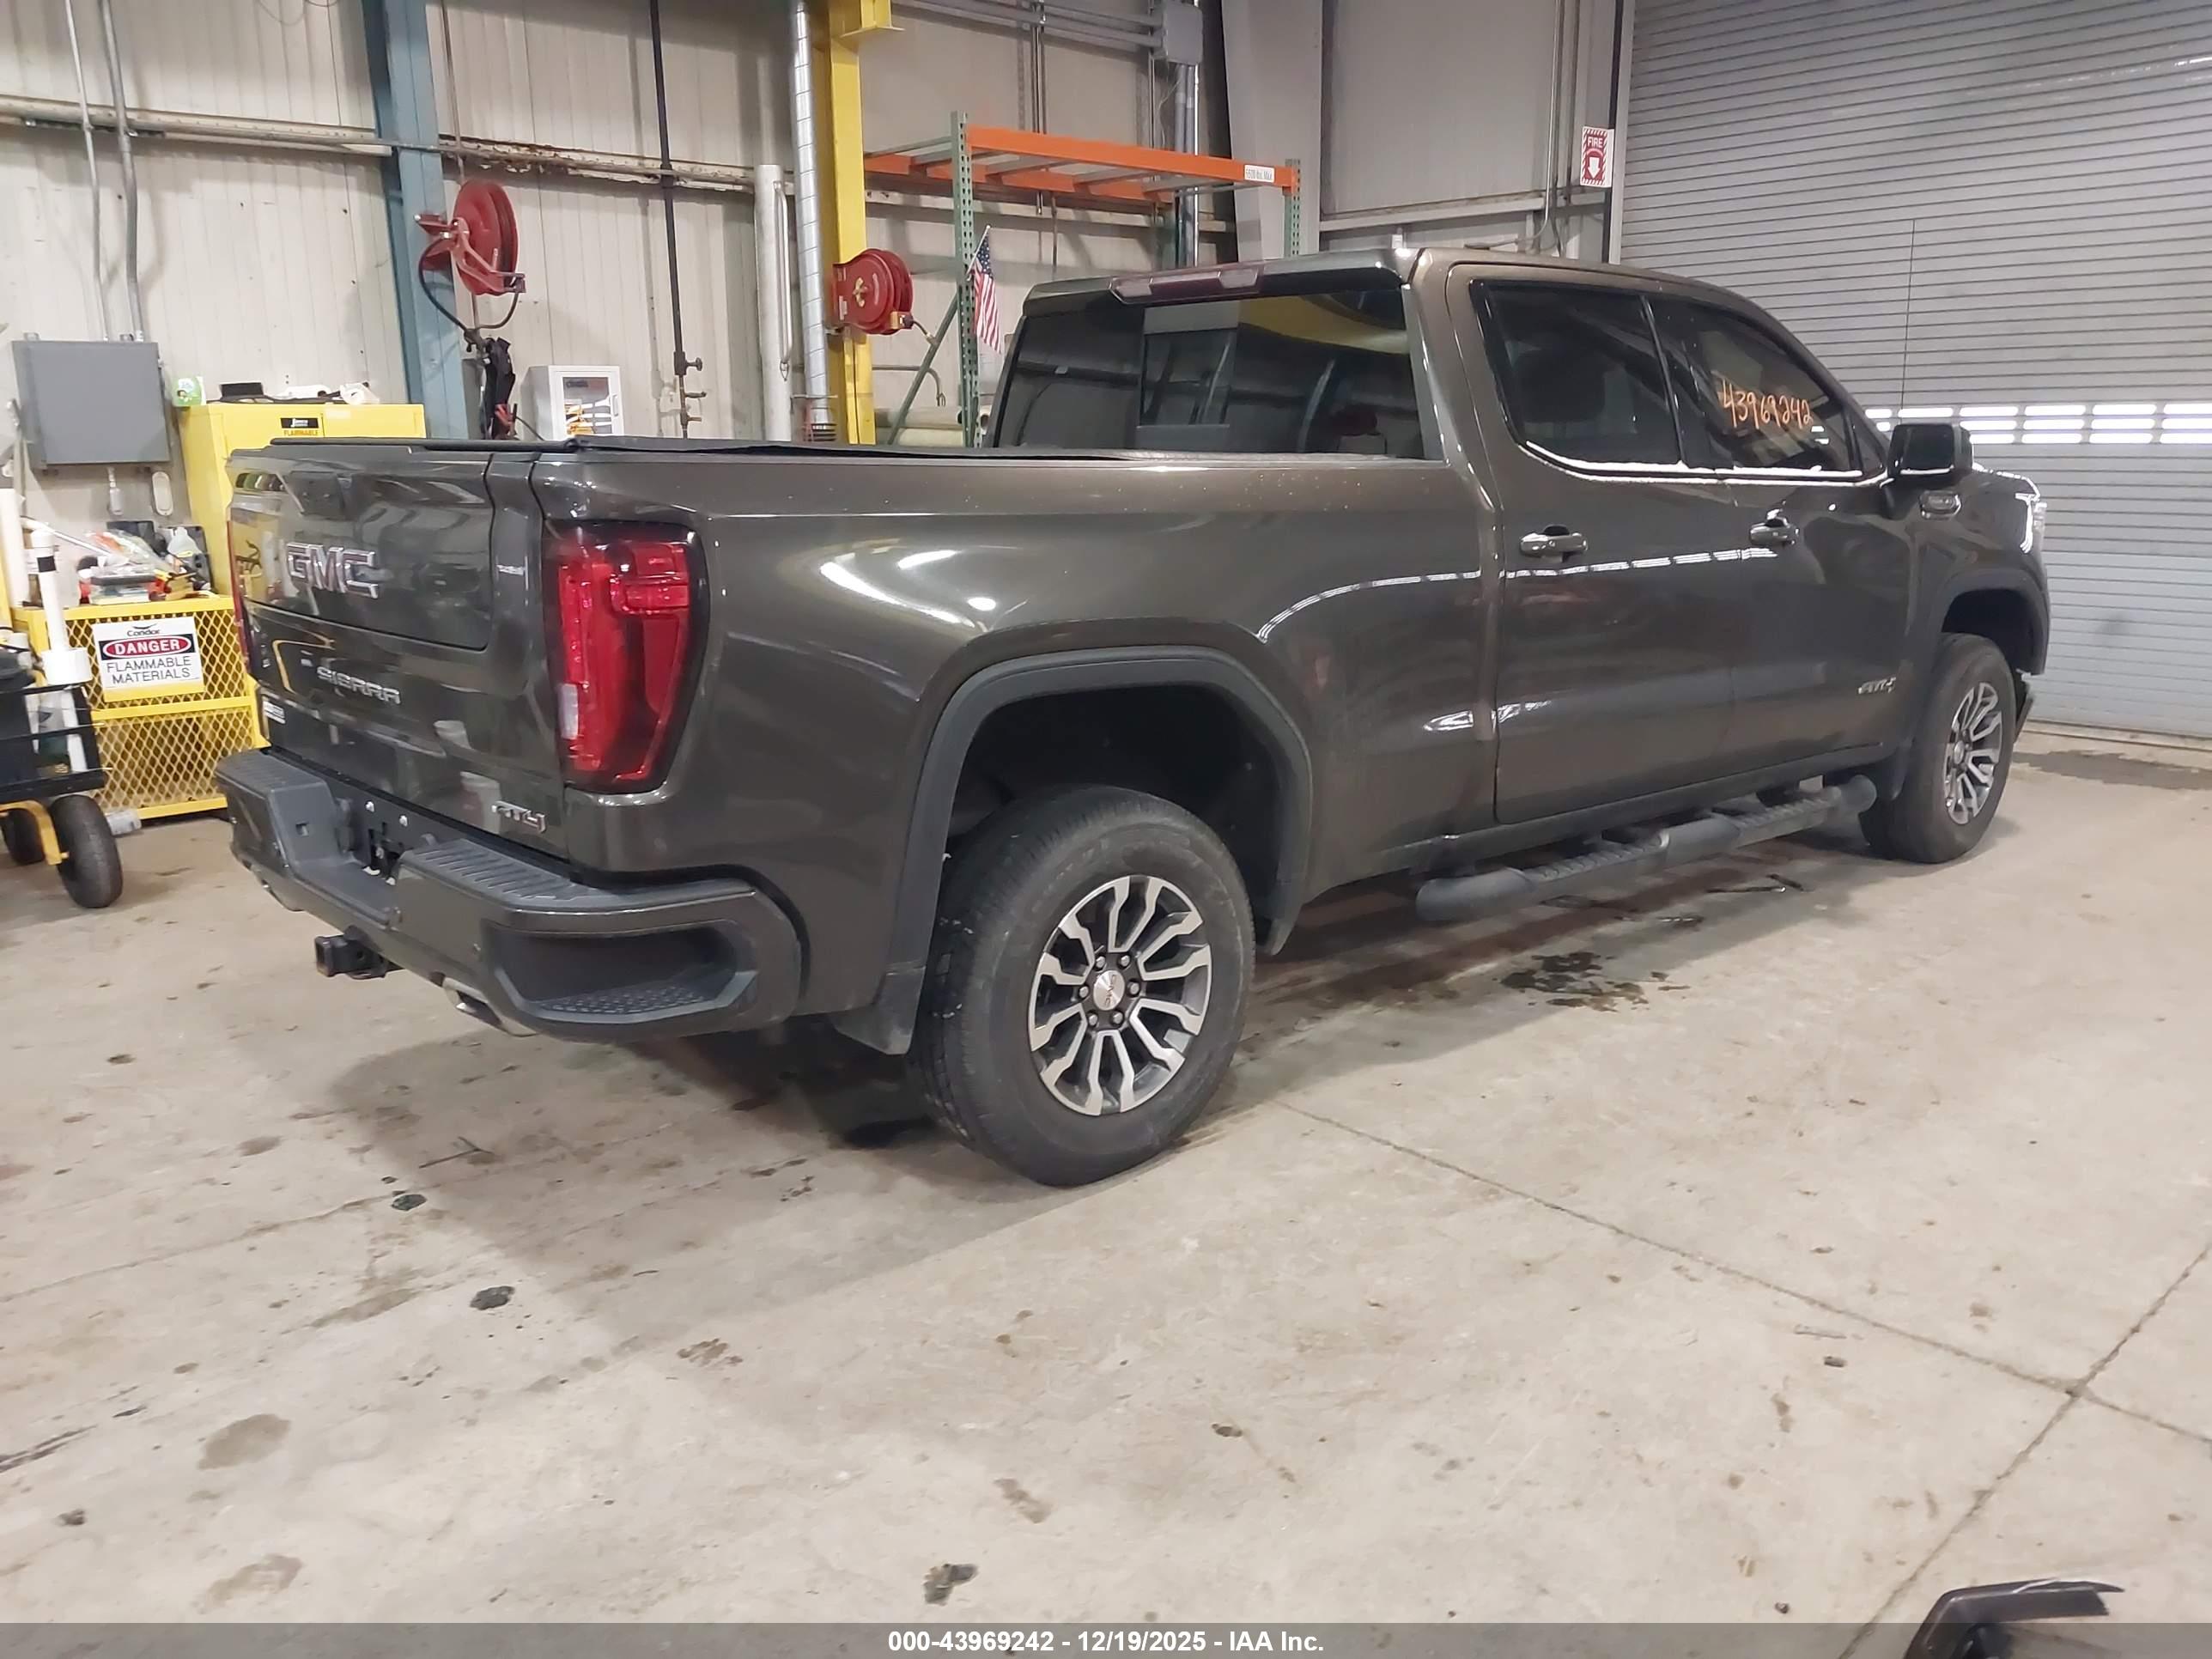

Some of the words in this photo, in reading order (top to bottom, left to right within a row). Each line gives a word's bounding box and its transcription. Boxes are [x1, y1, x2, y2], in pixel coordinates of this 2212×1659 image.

[1587, 136, 1604, 149] FIRE
[1722, 378, 1814, 429] 43969242
[286, 542, 379, 599] GMC
[114, 639, 181, 655] DANGER
[106, 655, 191, 672] FLAMMABLE
[112, 667, 190, 684] MATERIALS
[316, 665, 401, 704] SIERRA
